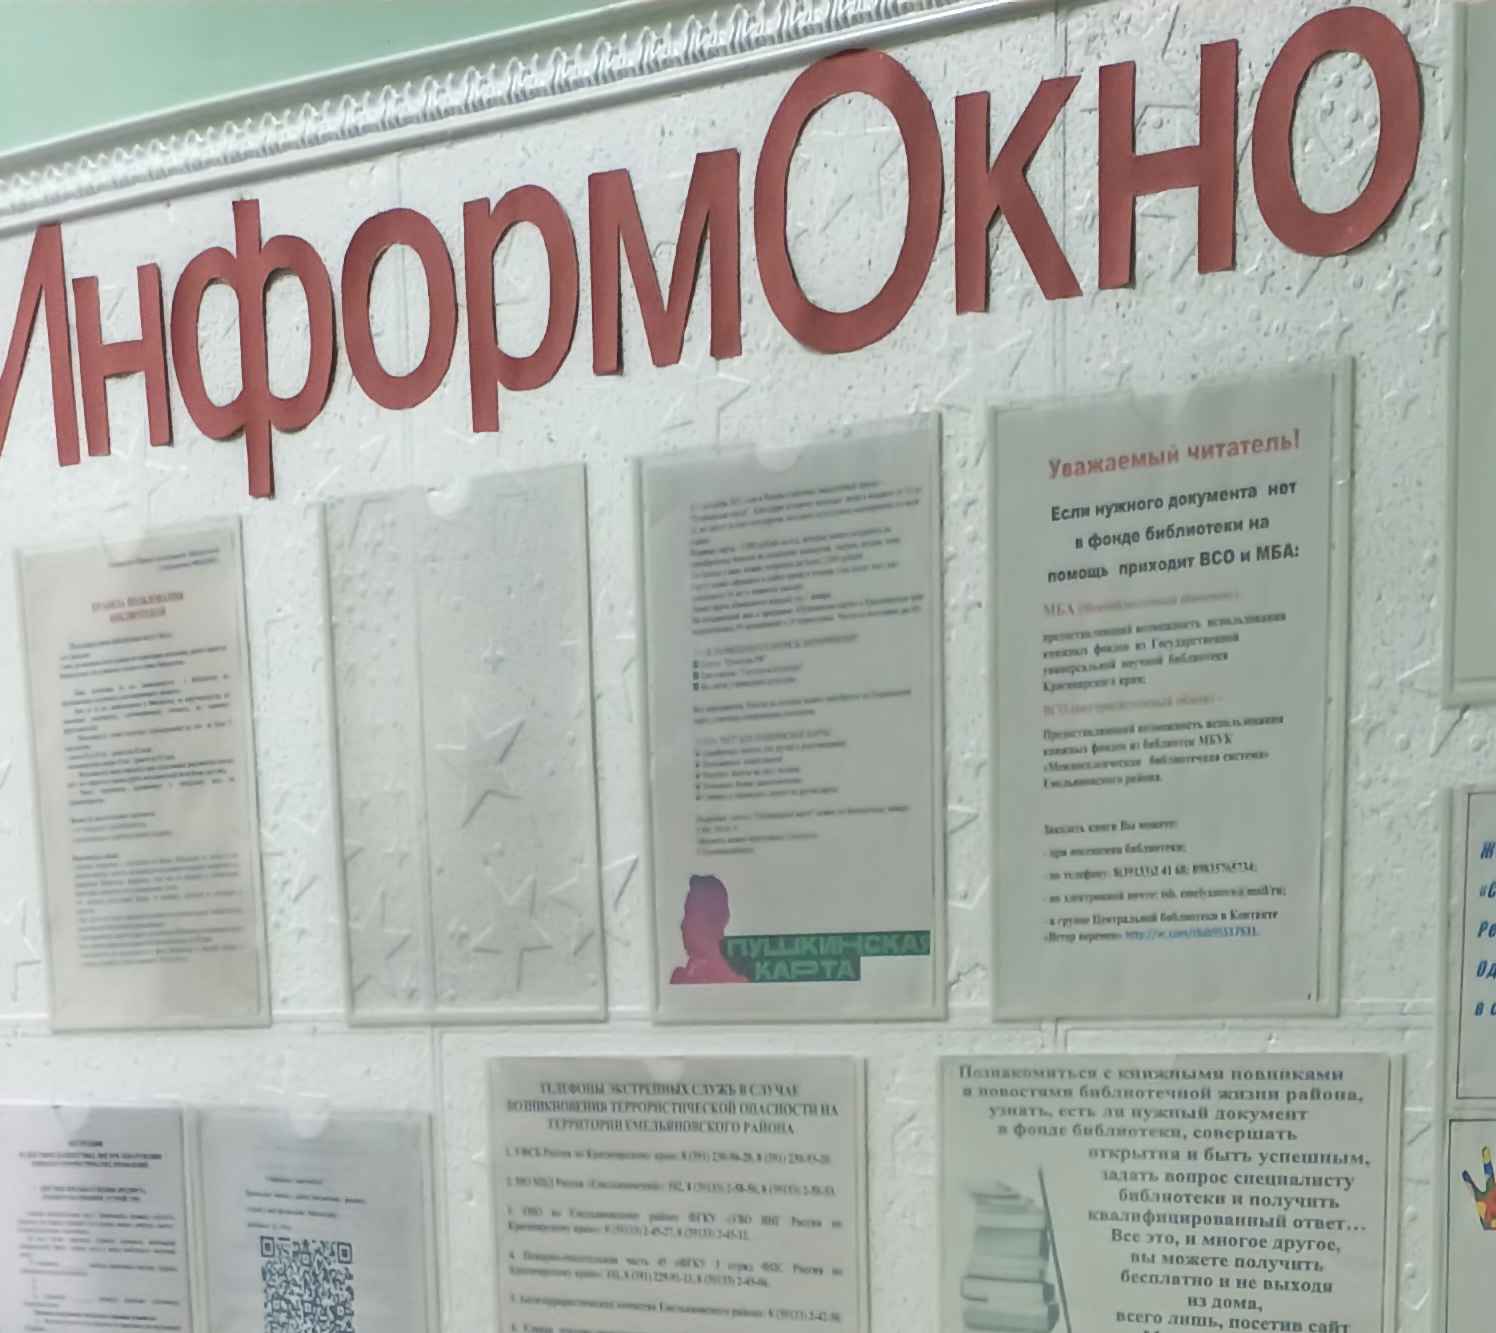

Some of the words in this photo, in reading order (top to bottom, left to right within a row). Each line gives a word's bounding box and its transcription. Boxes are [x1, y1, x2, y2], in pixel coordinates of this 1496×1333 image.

[1048, 442, 1179, 480] Уважаемый
[1187, 428, 1301, 460] читатель!
[1051, 504, 1091, 522] Если
[1095, 497, 1164, 518] нужного
[1168, 485, 1258, 510] документа
[1075, 537, 1084, 550] в
[1145, 518, 1244, 542] библиотеки
[1249, 516, 1270, 530] на
[1048, 566, 1109, 584] помощь
[1119, 555, 1195, 578] приходит
[1199, 549, 1235, 568] ВСО
[1240, 550, 1250, 564] и
[1256, 543, 1300, 562] МБА:
[754, 958, 858, 981] КАРТА
[1474, 1002, 1485, 1017] в
[958, 1065, 1097, 1080] Познакомиться
[1103, 1068, 1112, 1080] с
[1118, 1067, 1225, 1081] книжными
[1231, 1069, 1344, 1082] новинками
[978, 1086, 1074, 1098] новостями
[1079, 1085, 1212, 1100] библиотечной
[1218, 1089, 1280, 1101] жизни
[1285, 1087, 1364, 1104] района,
[988, 1105, 1053, 1119] узнать,
[1058, 1106, 1096, 1118] есть
[1103, 1106, 1125, 1118] ли
[1131, 1106, 1209, 1122] нужный
[1214, 1108, 1309, 1124] документ
[1013, 1122, 1068, 1139] фонде
[1193, 1129, 1298, 1143] совершать
[1088, 1148, 1180, 1163] открытия
[1187, 1150, 1198, 1161] и
[1203, 1147, 1252, 1163] быть
[1258, 1150, 1370, 1168] успешным,
[1101, 1169, 1159, 1183] задать
[1165, 1171, 1229, 1187] вопрос
[1234, 1173, 1355, 1192] специалисту
[1119, 1187, 1226, 1206] библиотеки
[1232, 1194, 1243, 1206] и
[1249, 1194, 1340, 1211] получить
[1088, 1209, 1287, 1230] квалифицированный
[1147, 1232, 1180, 1247] это,
[1185, 1235, 1196, 1246] и
[1202, 1235, 1268, 1248] многое
[1272, 1238, 1341, 1254] другое,
[1131, 1252, 1156, 1264] вы
[1161, 1252, 1229, 1267] можете
[1234, 1256, 1324, 1273] получить
[1120, 1269, 1213, 1288] бесплатно
[1219, 1277, 1230, 1288] и
[1236, 1278, 1257, 1290] не
[1263, 1280, 1333, 1294] выходя
[1187, 1296, 1207, 1308] из
[1211, 1297, 1263, 1312] дома,
[1116, 1311, 1163, 1325] всего
[1168, 1314, 1224, 1330] лишь,
[1228, 1317, 1303, 1333] посетив
